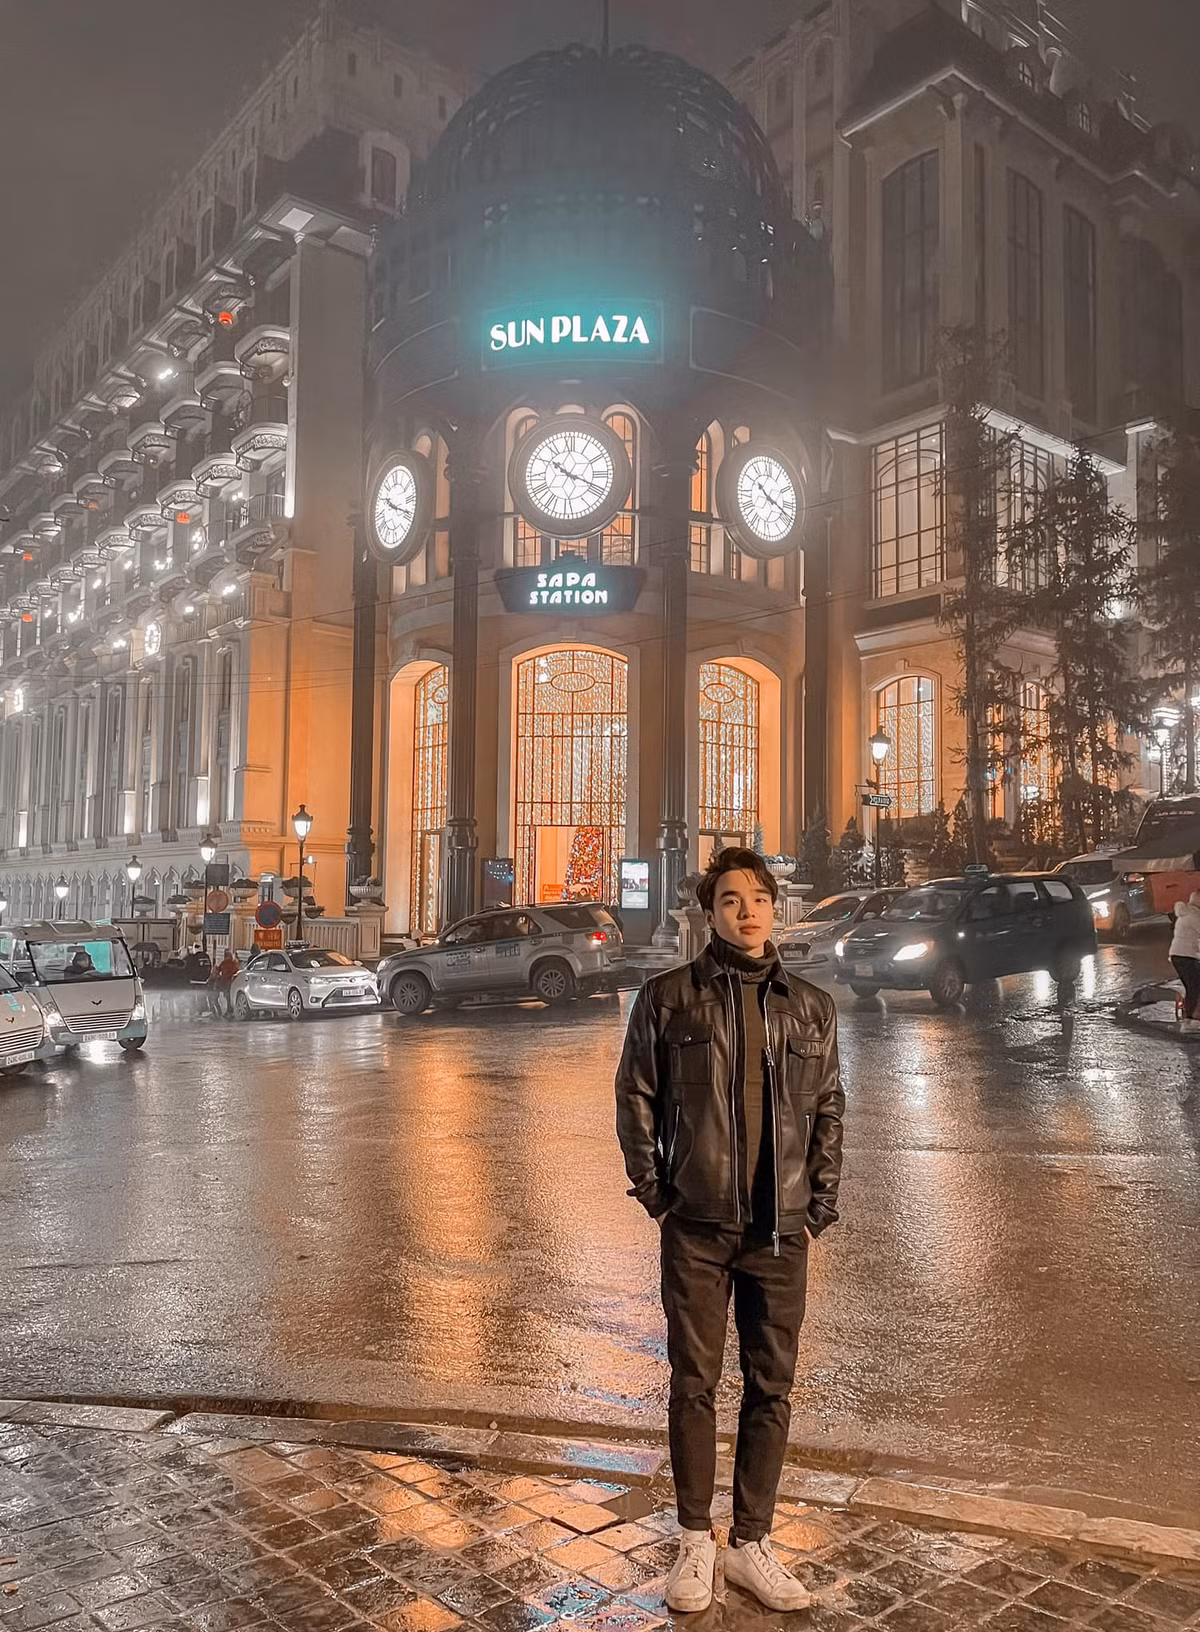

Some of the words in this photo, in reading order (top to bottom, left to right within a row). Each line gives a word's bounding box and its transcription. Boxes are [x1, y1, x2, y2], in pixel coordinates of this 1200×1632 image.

[490, 318, 545, 351] SUN
[551, 315, 650, 344] PLAZA
[537, 572, 597, 588] SAPA
[529, 590, 609, 605] STATION
